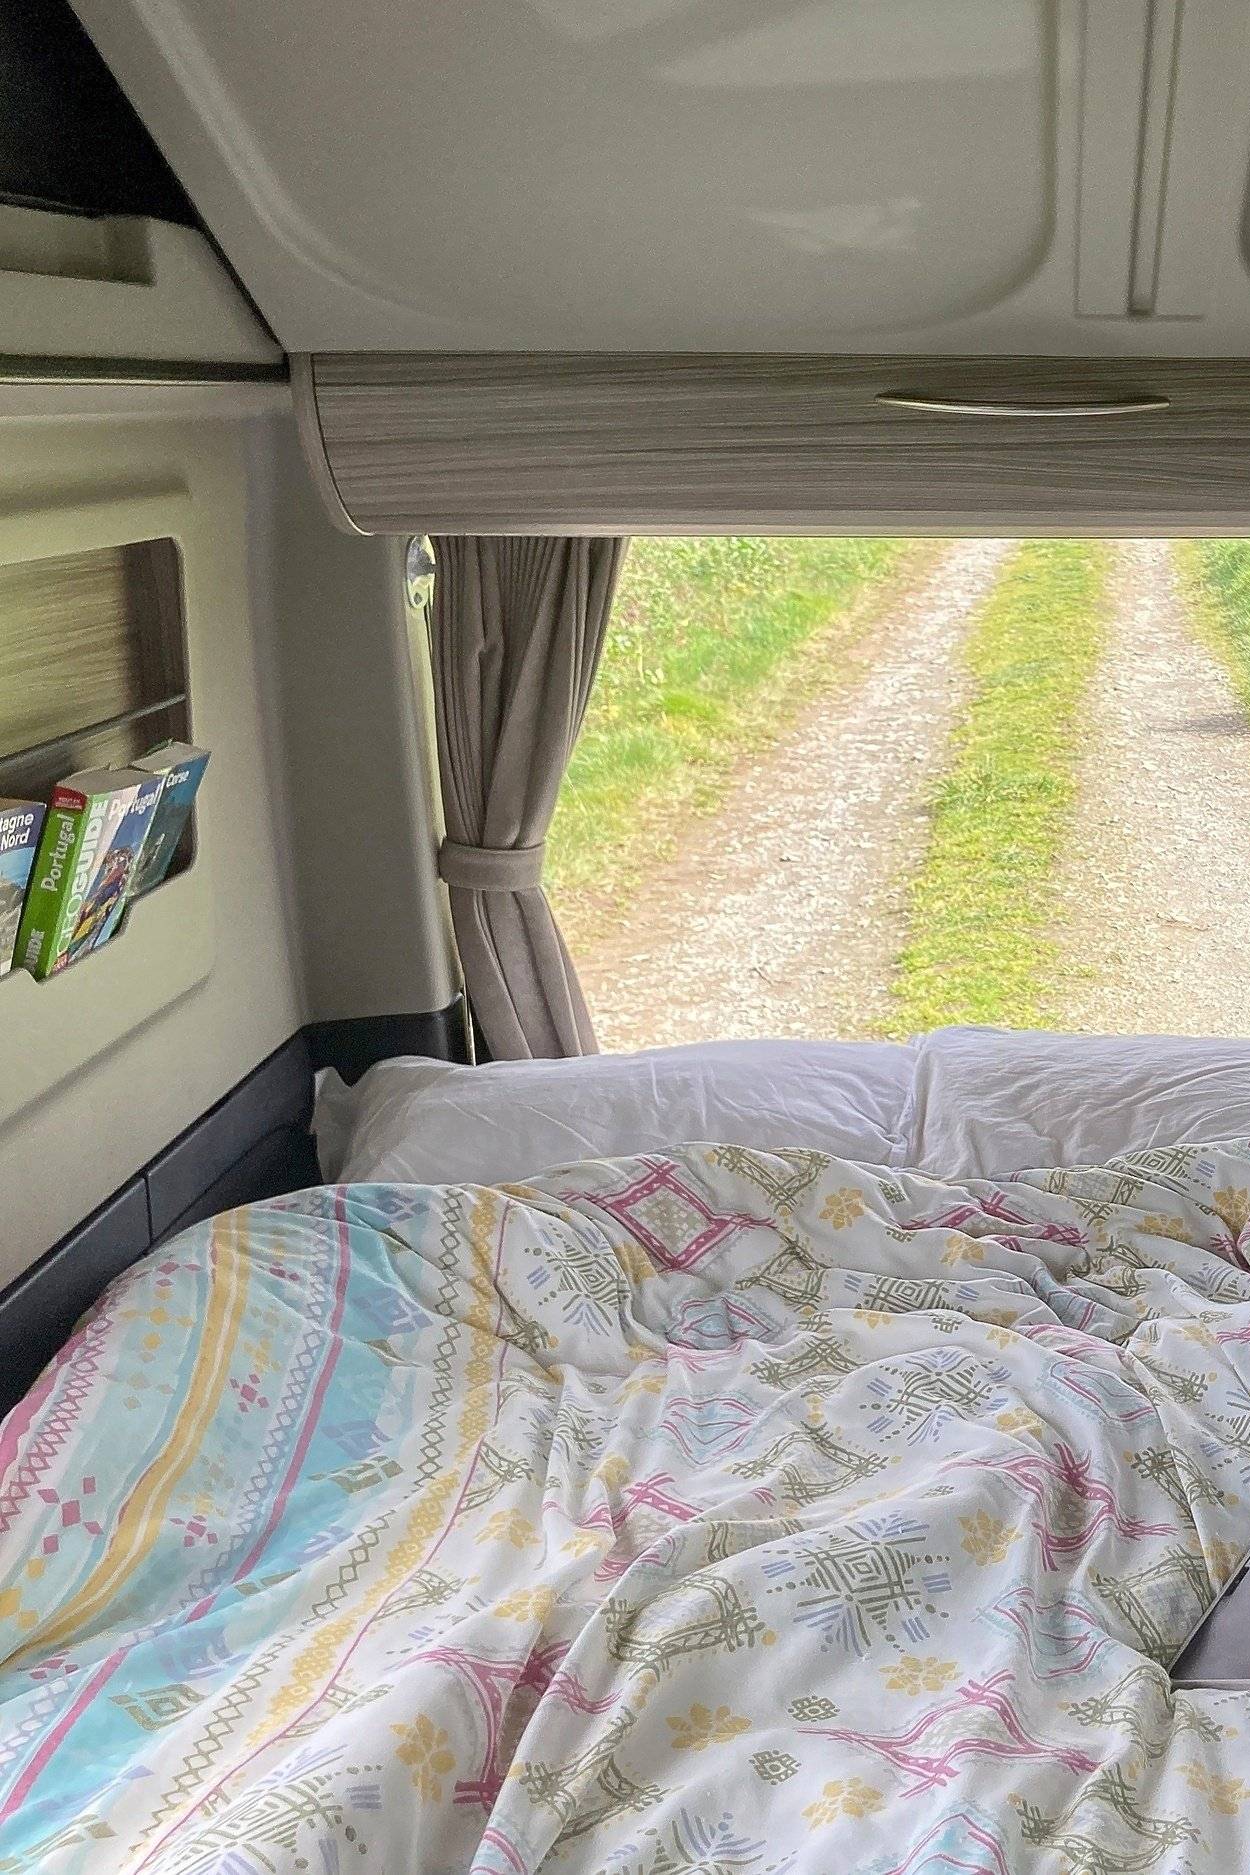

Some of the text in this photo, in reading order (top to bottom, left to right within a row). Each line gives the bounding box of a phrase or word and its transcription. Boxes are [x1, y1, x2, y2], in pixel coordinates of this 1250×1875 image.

[166, 770, 190, 788] Corse
[108, 783, 161, 820] Portugal
[0, 827, 31, 850] Nord
[41, 813, 76, 892] Portugal
